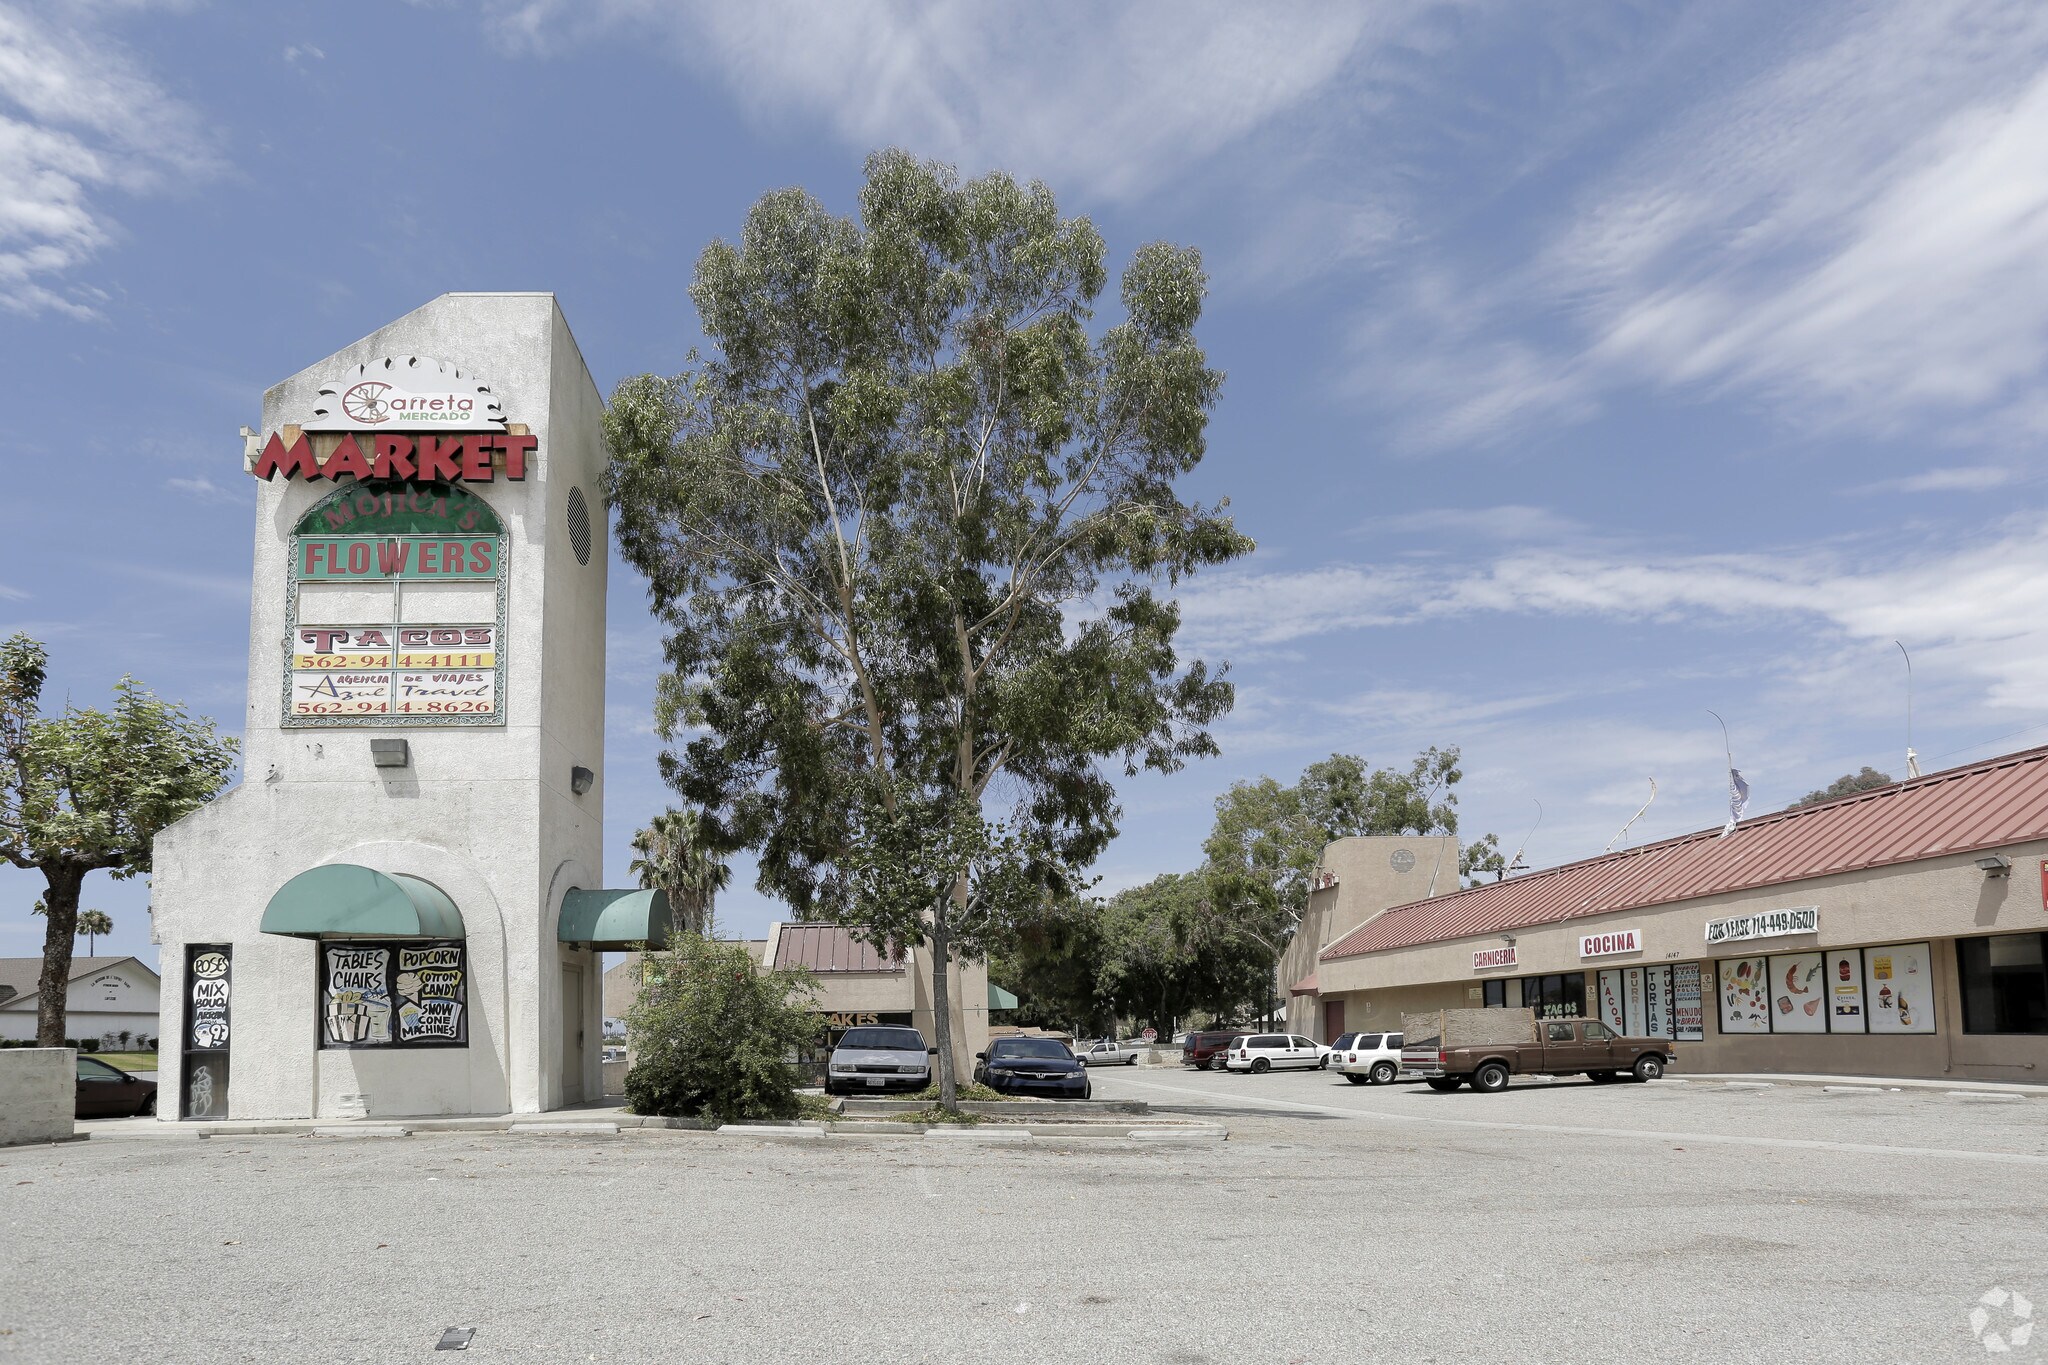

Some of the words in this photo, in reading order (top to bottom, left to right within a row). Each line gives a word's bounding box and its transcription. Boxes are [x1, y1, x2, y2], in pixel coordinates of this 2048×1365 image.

[399, 411, 471, 421] MERCADO
[252, 430, 539, 484] MARKET
[304, 541, 492, 575] FLOWERS
[300, 628, 492, 655] TACOS
[298, 674, 388, 700] Azul
[401, 684, 490, 697] Travel
[336, 673, 389, 684] AGENCIA
[403, 674, 423, 682] DE
[432, 673, 484, 685] VIAJES
[1708, 923, 1725, 941] FOR
[1584, 932, 1635, 955] COCINA
[195, 956, 228, 974] ROSES
[332, 951, 384, 970] TABLES
[403, 950, 458, 966] POPCORN
[1473, 947, 1516, 967] CARNICERIA
[332, 971, 382, 990] CHAIRS
[420, 971, 458, 983] COTTON
[421, 983, 458, 997] CANDY
[421, 1003, 454, 1016] SNOW
[1543, 1001, 1577, 1015] TACOS
[1601, 976, 1622, 1026] TACOS
[1630, 971, 1640, 1036] BURRITOS
[1648, 972, 1658, 1032] TORTAS
[1664, 970, 1674, 1035] PUPUSAS
[418, 1015, 451, 1025] CONE
[823, 1012, 879, 1027] AKES
[402, 1025, 455, 1037] MACHINES
